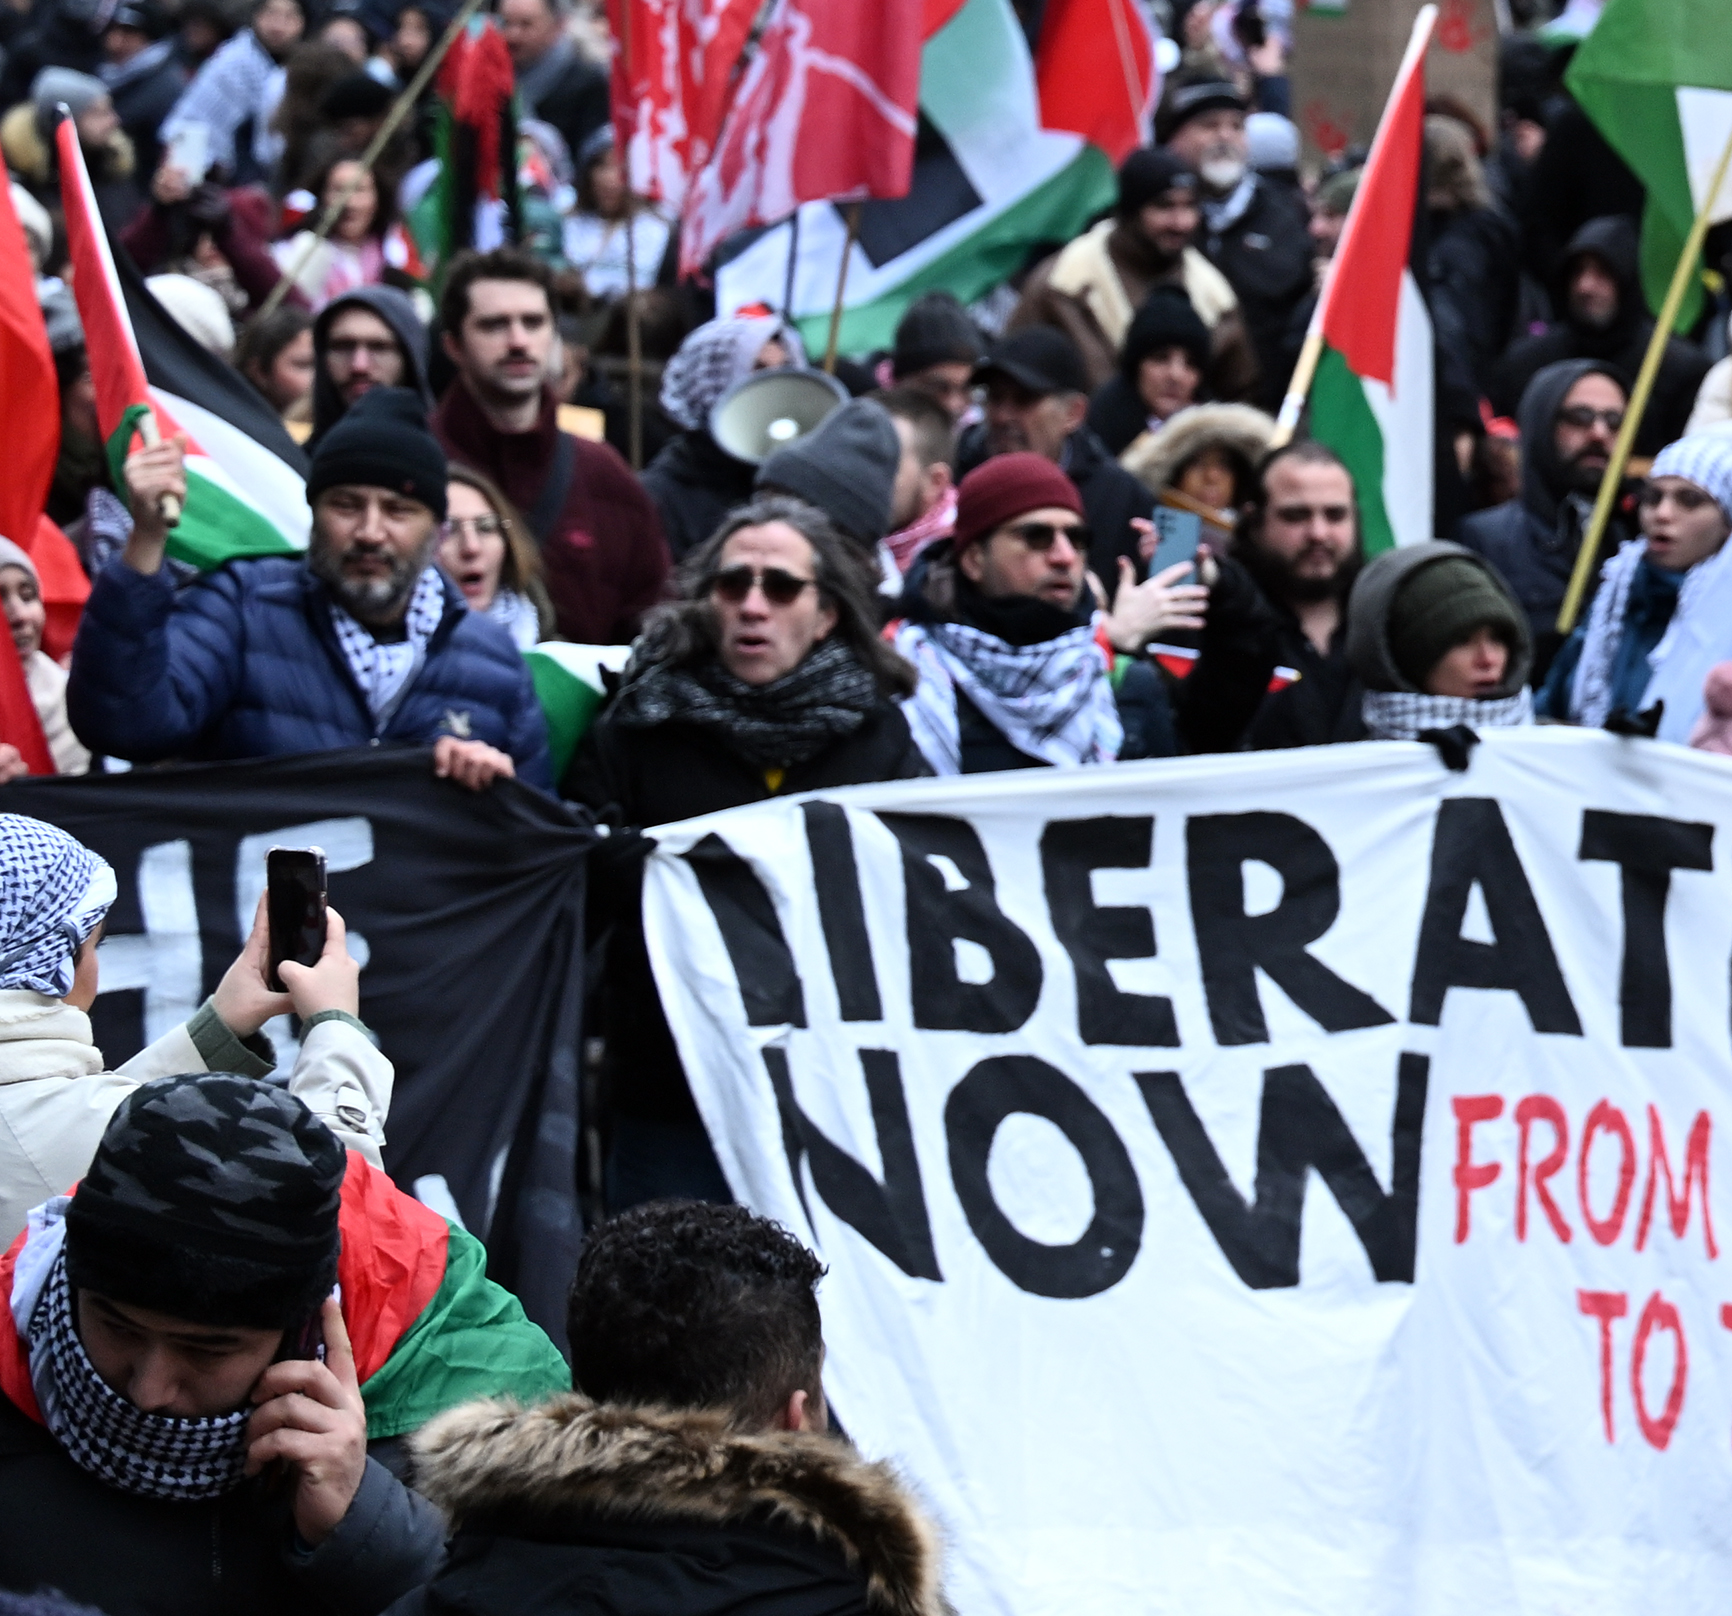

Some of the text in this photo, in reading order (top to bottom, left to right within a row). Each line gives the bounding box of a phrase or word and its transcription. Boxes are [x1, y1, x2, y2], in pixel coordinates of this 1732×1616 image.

[760, 1047, 1430, 1299] NOW
[1450, 1094, 1719, 1260] FROM
[1577, 1289, 1687, 1451] TO
